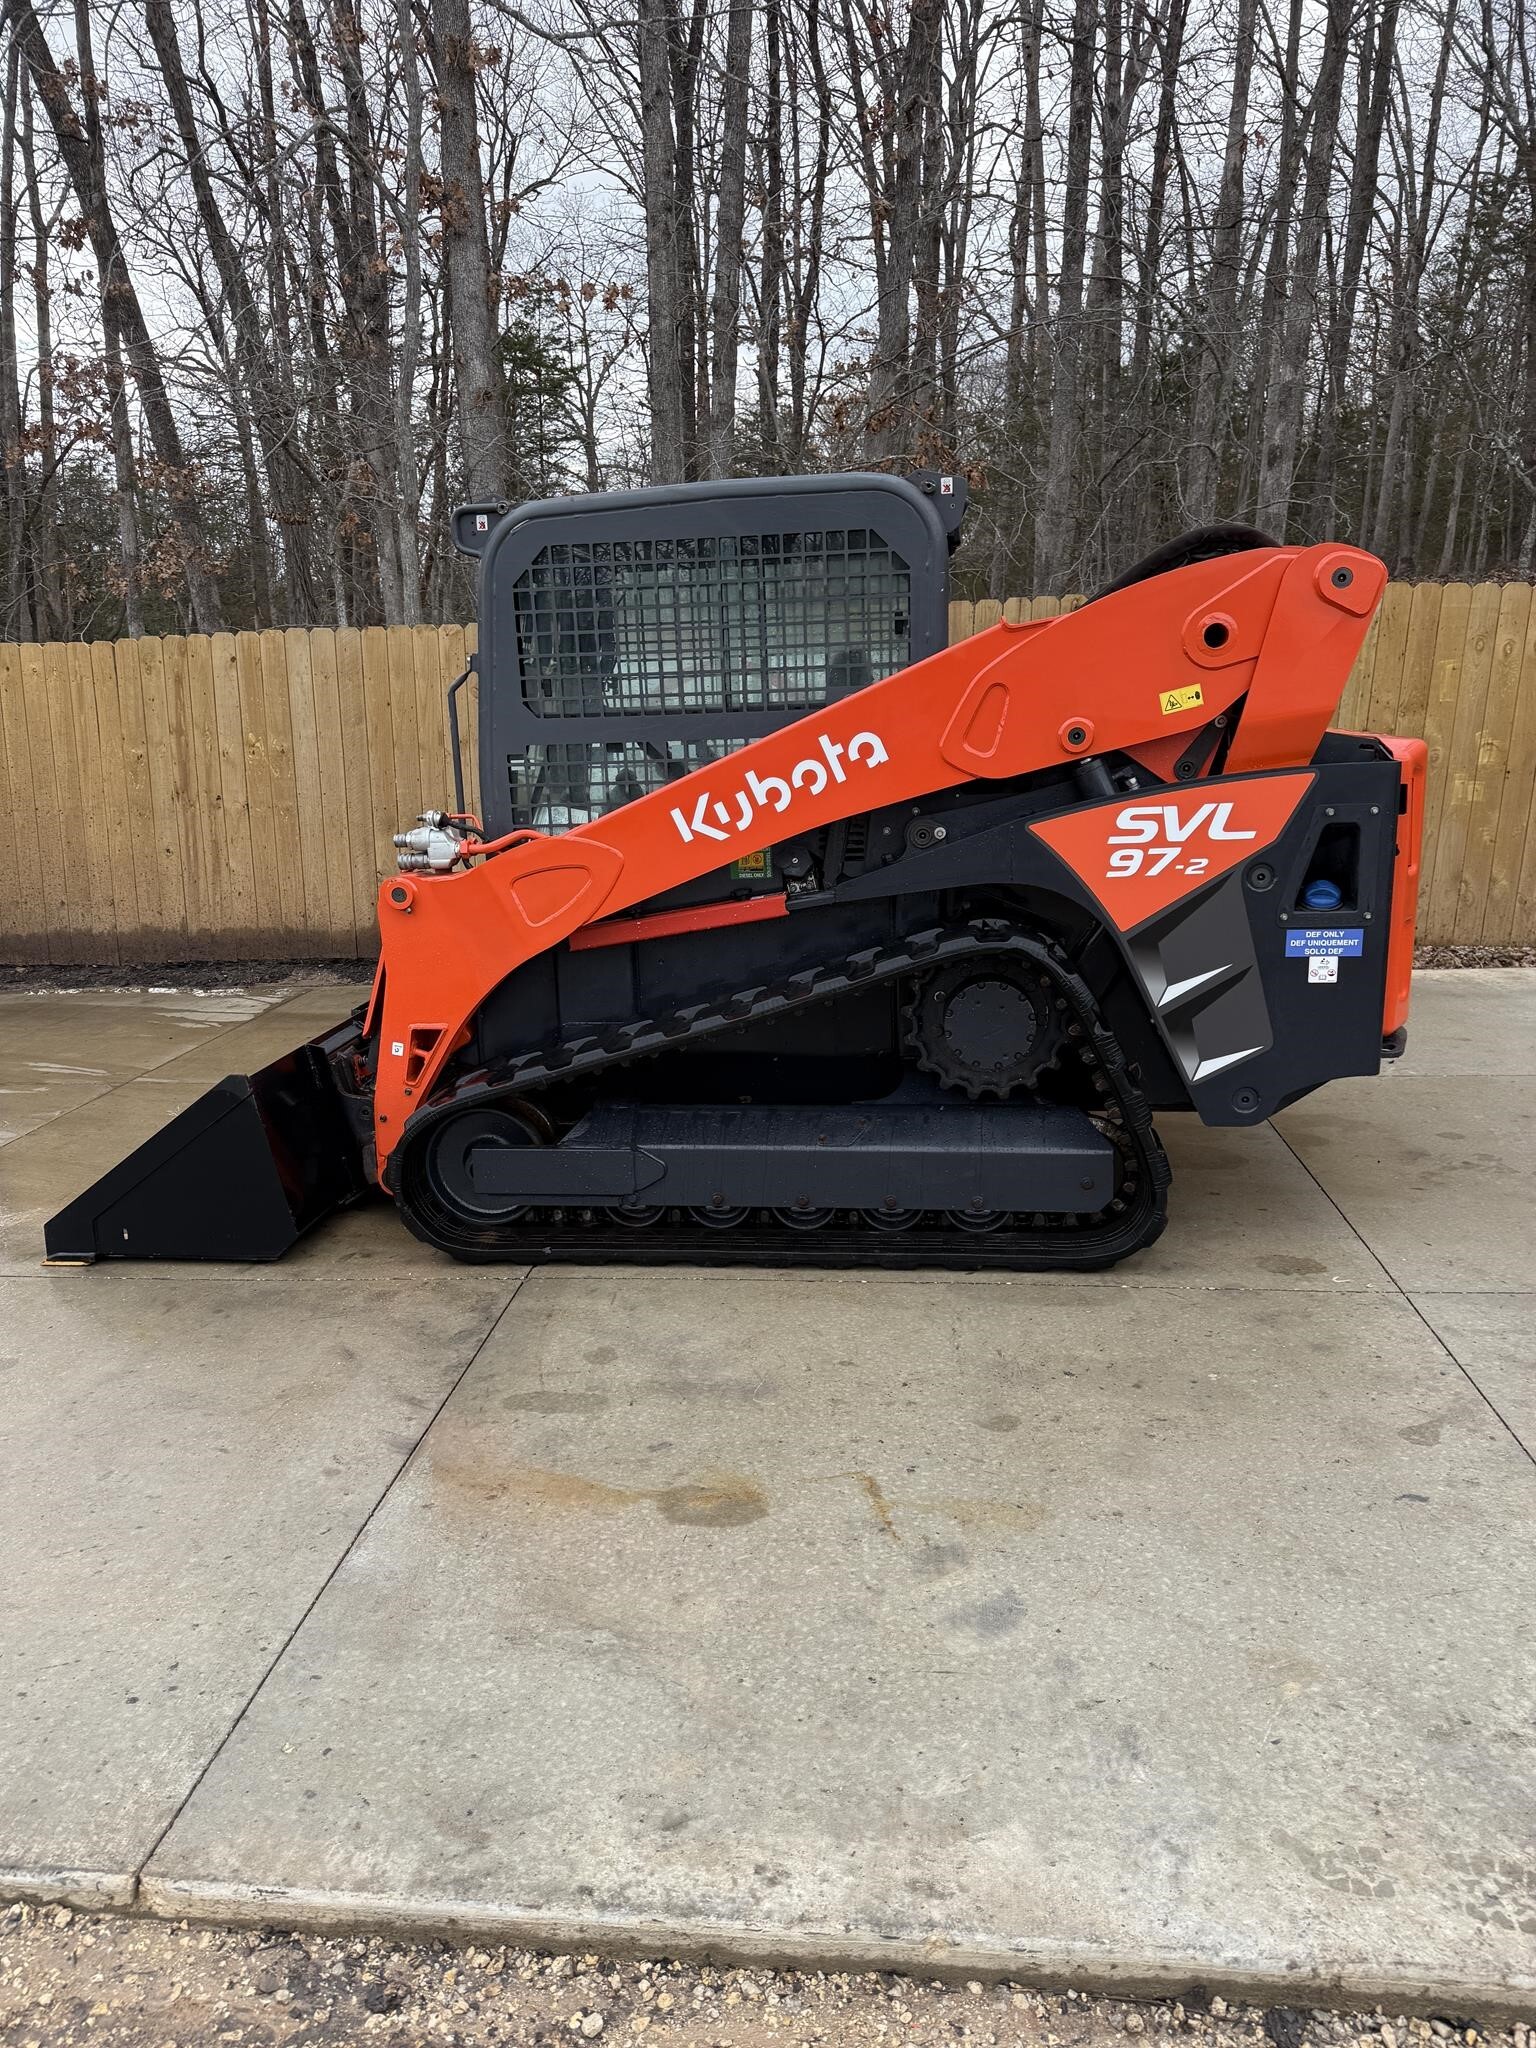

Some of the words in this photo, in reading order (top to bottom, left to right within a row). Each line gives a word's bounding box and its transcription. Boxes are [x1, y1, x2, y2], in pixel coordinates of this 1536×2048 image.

[669, 731, 889, 843] Kubota
[1107, 802, 1257, 845] SVL
[1105, 847, 1209, 878] 97-2
